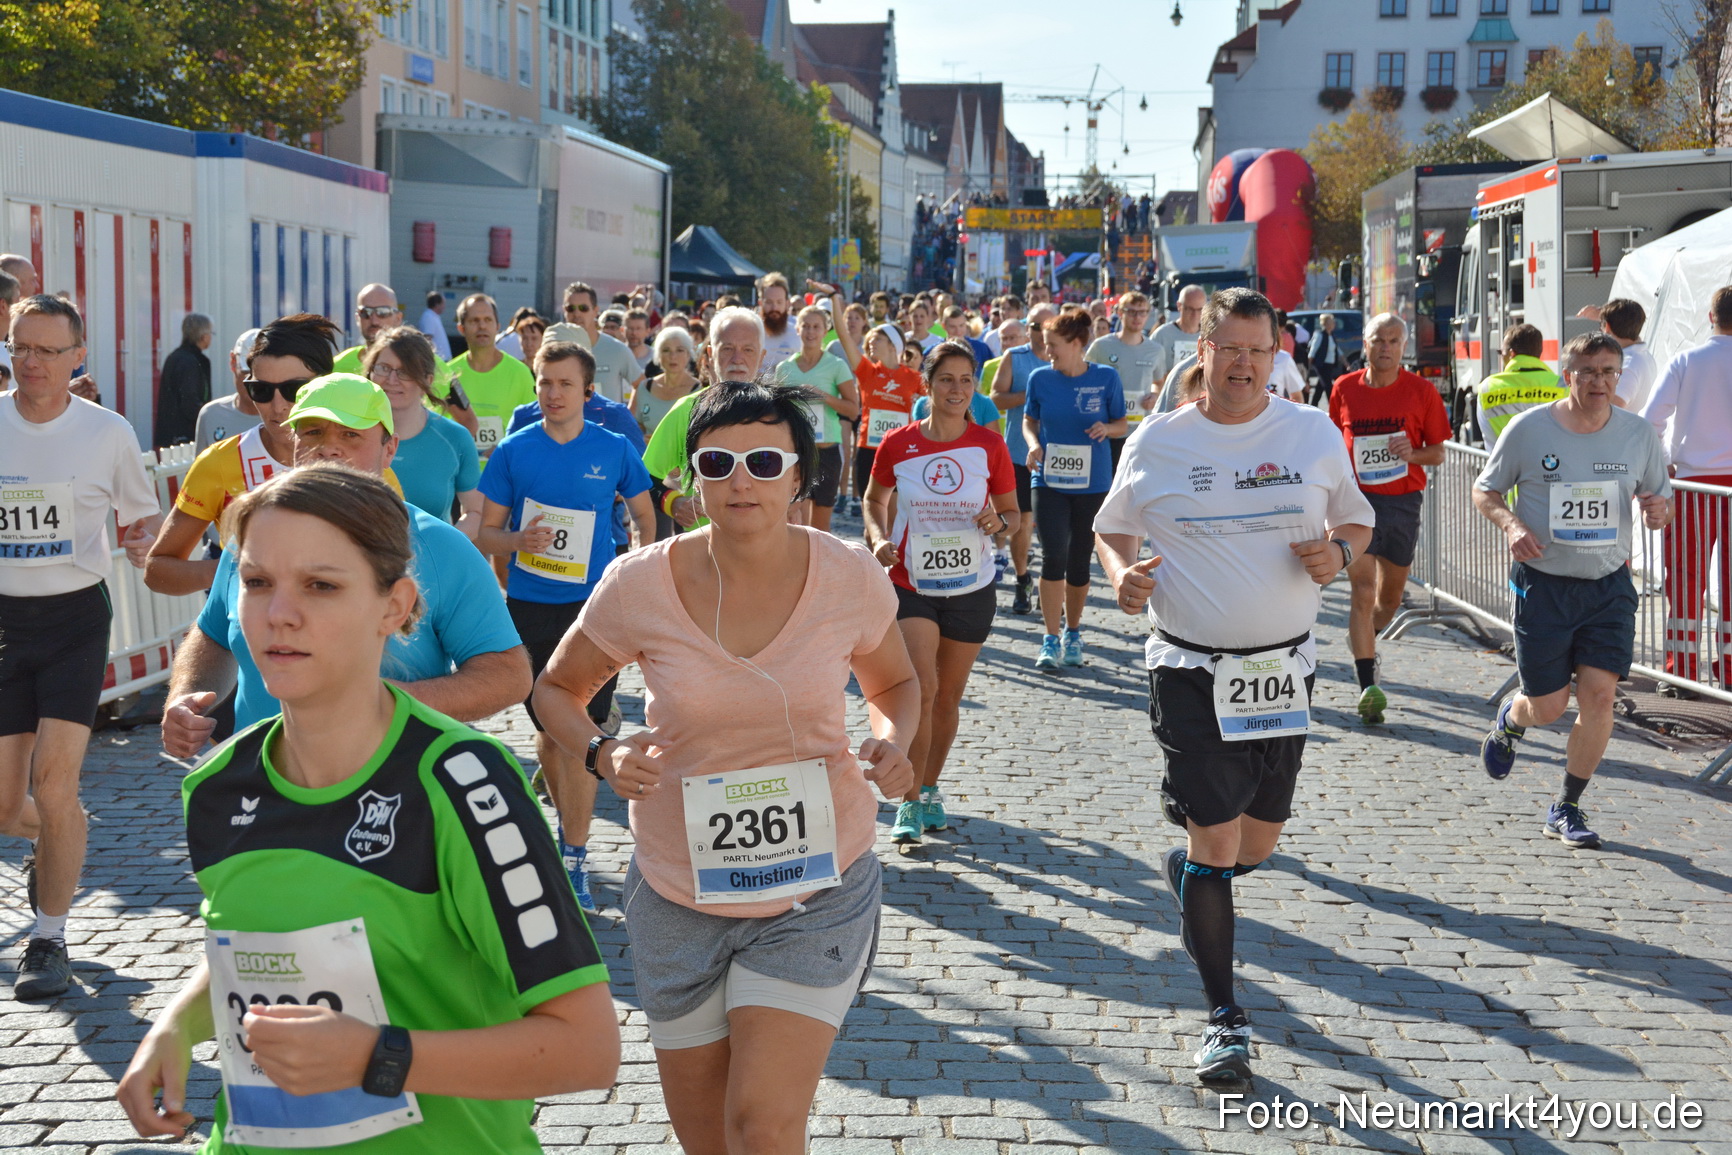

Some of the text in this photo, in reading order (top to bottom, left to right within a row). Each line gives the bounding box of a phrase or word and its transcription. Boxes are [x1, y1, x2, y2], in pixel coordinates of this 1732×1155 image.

[1010, 212, 1056, 224] START
[1487, 390, 1558, 403] Org.-Leiter
[1050, 456, 1084, 471] 2999
[1593, 463, 1628, 472] BOCK
[1188, 471, 1216, 480] Laufshirt
[3, 489, 45, 500] BOCK
[1572, 488, 1603, 496] BOCK
[1561, 500, 1608, 519] 2151
[931, 536, 961, 545] BOCK
[1575, 530, 1598, 540] Erwin
[0, 543, 62, 558] TEFAN
[531, 557, 567, 573] Leander
[922, 548, 971, 570] 2638
[936, 580, 963, 589] Sevinc
[1243, 659, 1282, 670] BOCK
[1229, 674, 1296, 703] 2104
[1244, 717, 1282, 731] Jürgen
[725, 777, 789, 799] BOCK
[708, 801, 806, 850] 2361
[356, 842, 373, 852] e.V.
[723, 848, 796, 863] PARTL Neumarkt
[730, 865, 804, 888] Christine
[234, 951, 303, 974] BOCK
